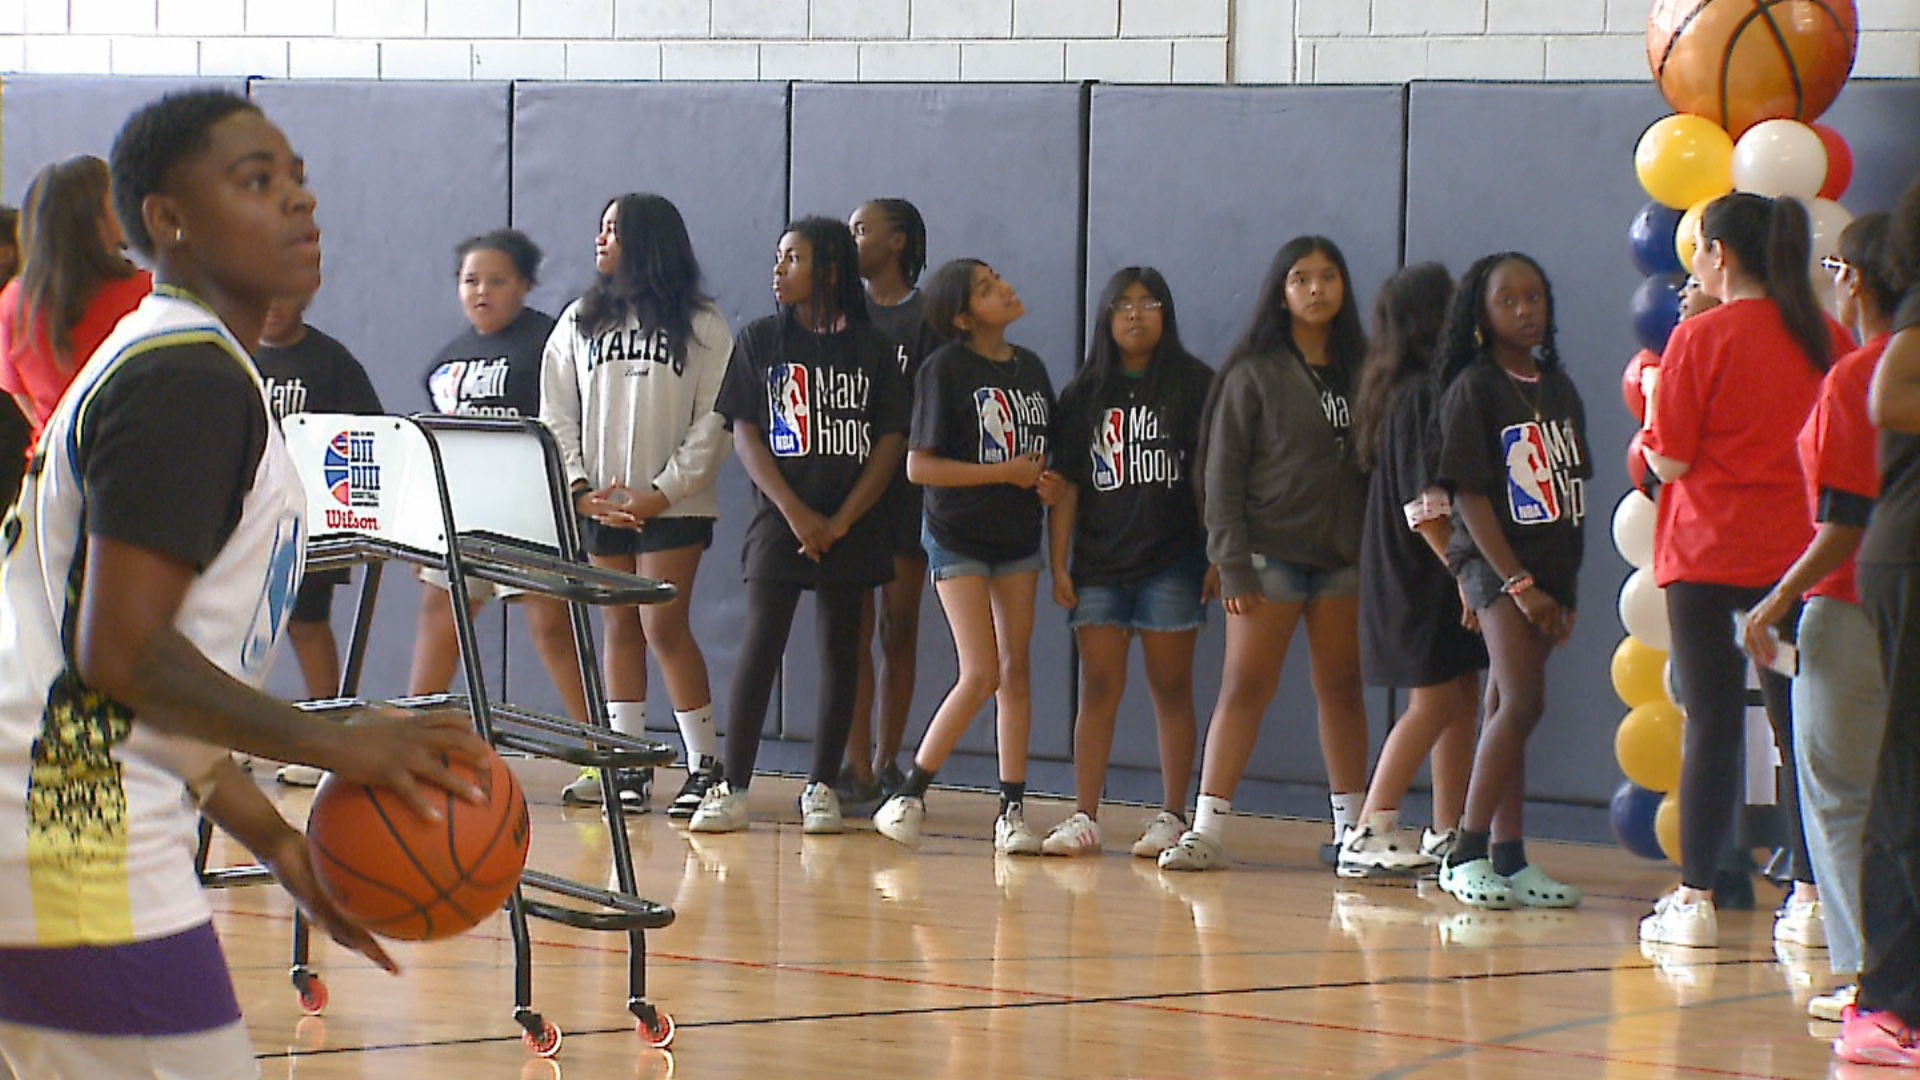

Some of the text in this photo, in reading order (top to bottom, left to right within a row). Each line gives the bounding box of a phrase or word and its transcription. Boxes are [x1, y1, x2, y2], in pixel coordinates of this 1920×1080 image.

[350, 438, 374, 463] DII
[350, 465, 381, 491] DIII
[1128, 443, 1180, 489] Hoop
[325, 509, 378, 530] Wilson
